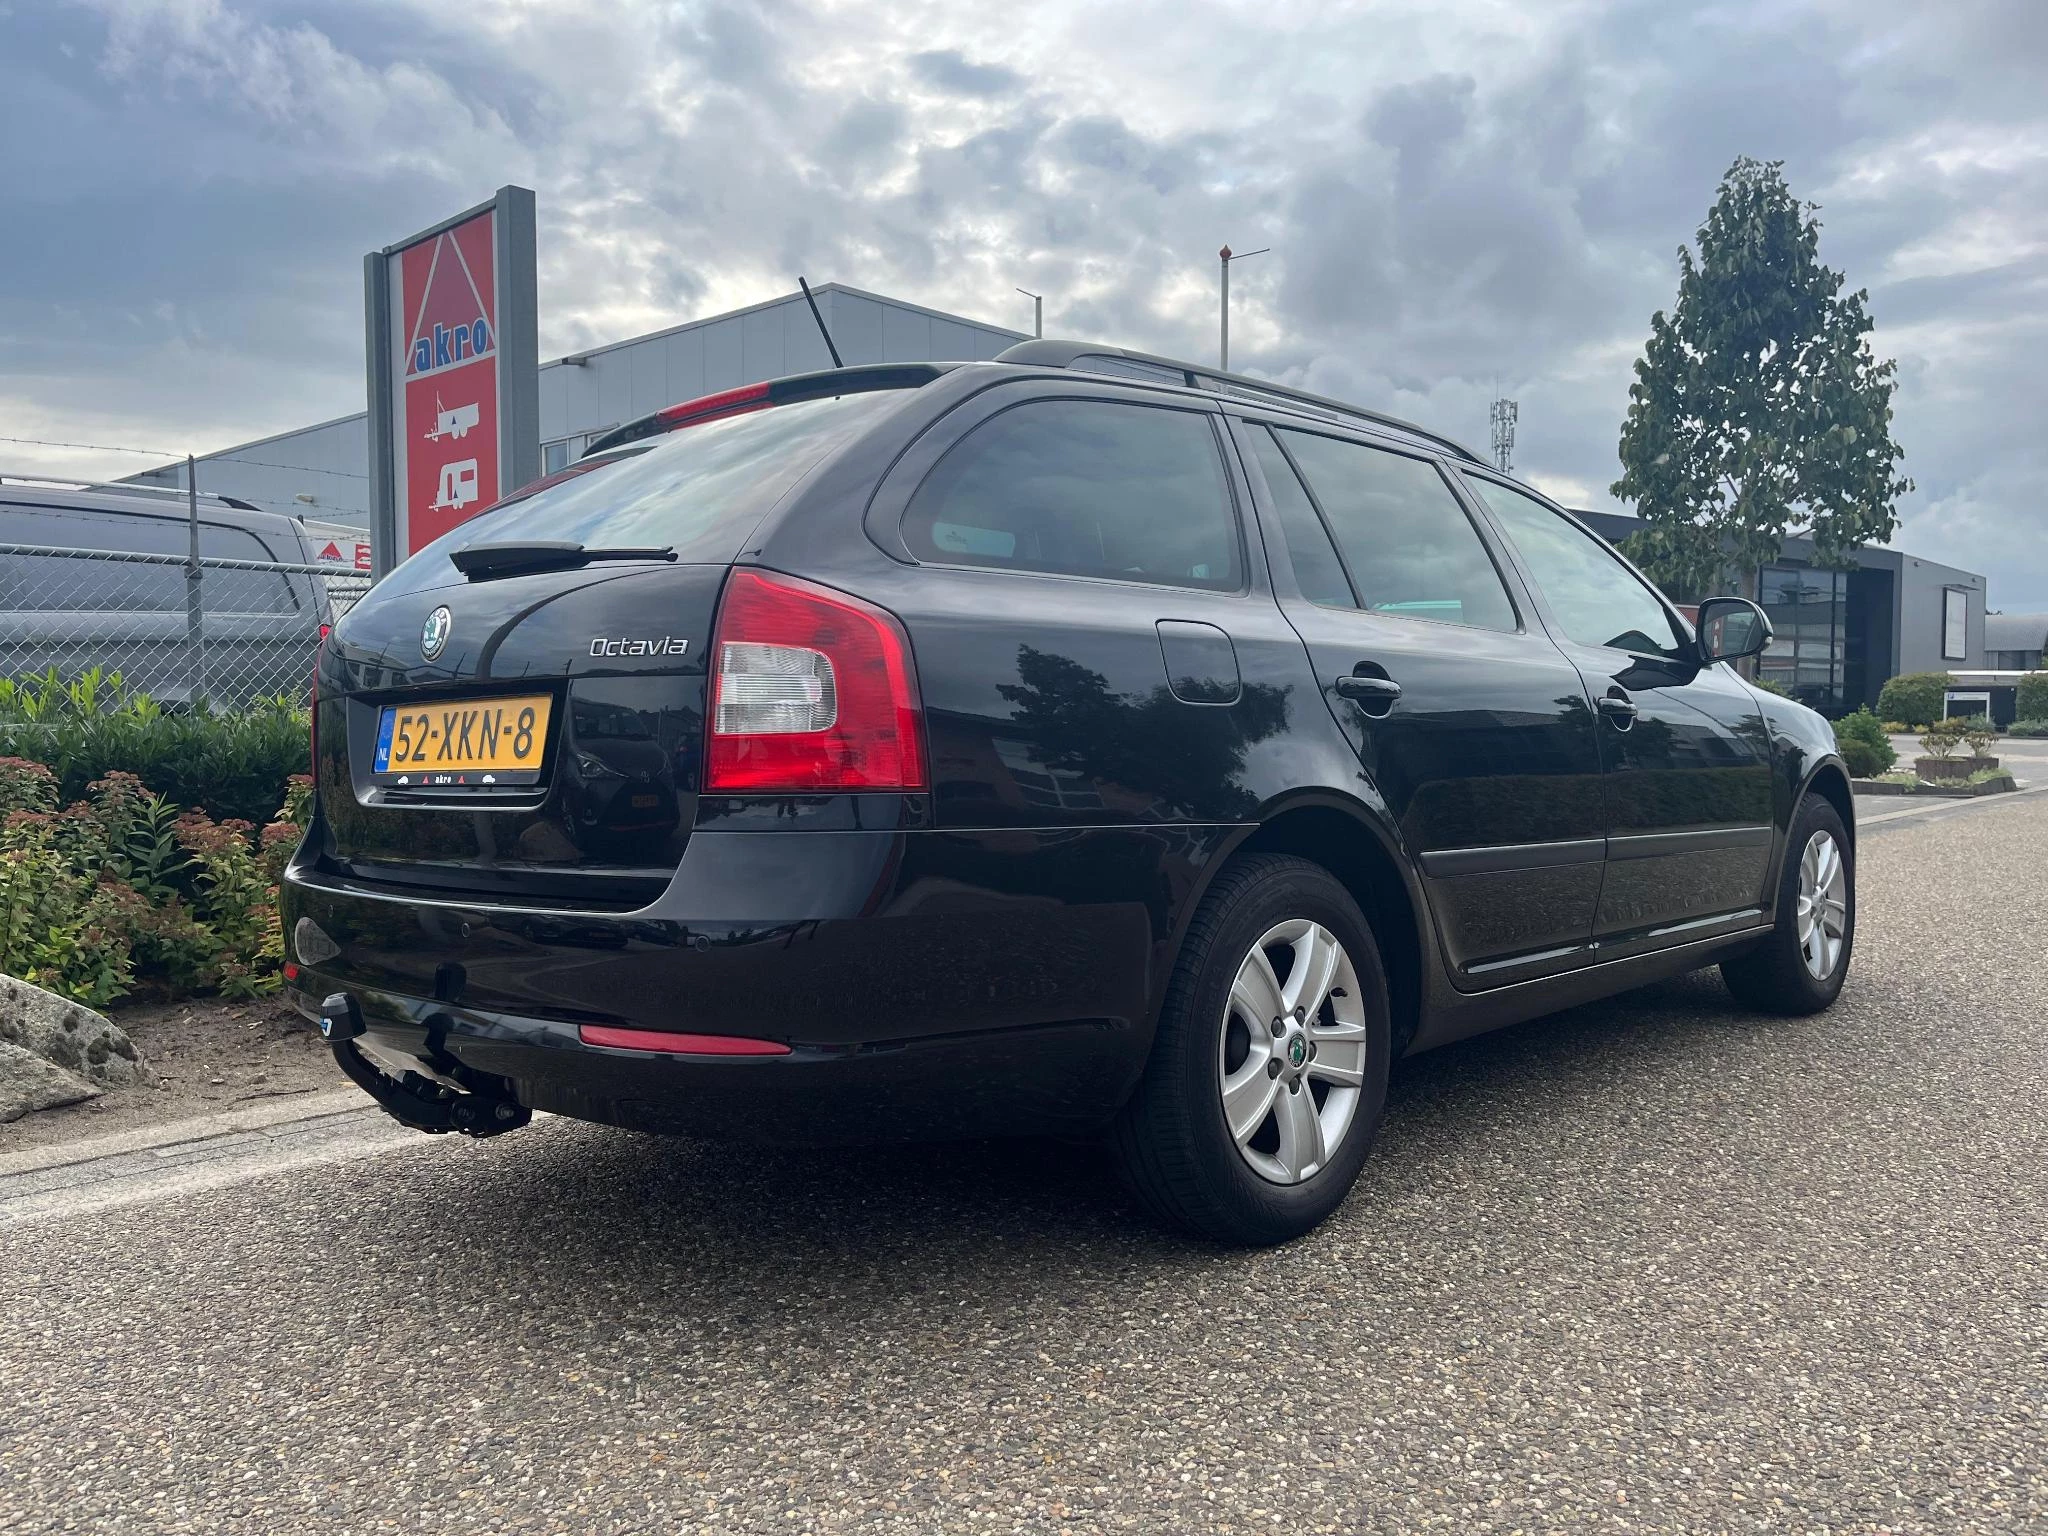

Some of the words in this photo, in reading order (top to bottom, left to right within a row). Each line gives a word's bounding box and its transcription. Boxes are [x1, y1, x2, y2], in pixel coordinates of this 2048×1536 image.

[415, 317, 488, 373] akro
[589, 635, 689, 657] Octavia
[395, 706, 535, 762] 52-XKN-8
[378, 747, 388, 761] NL
